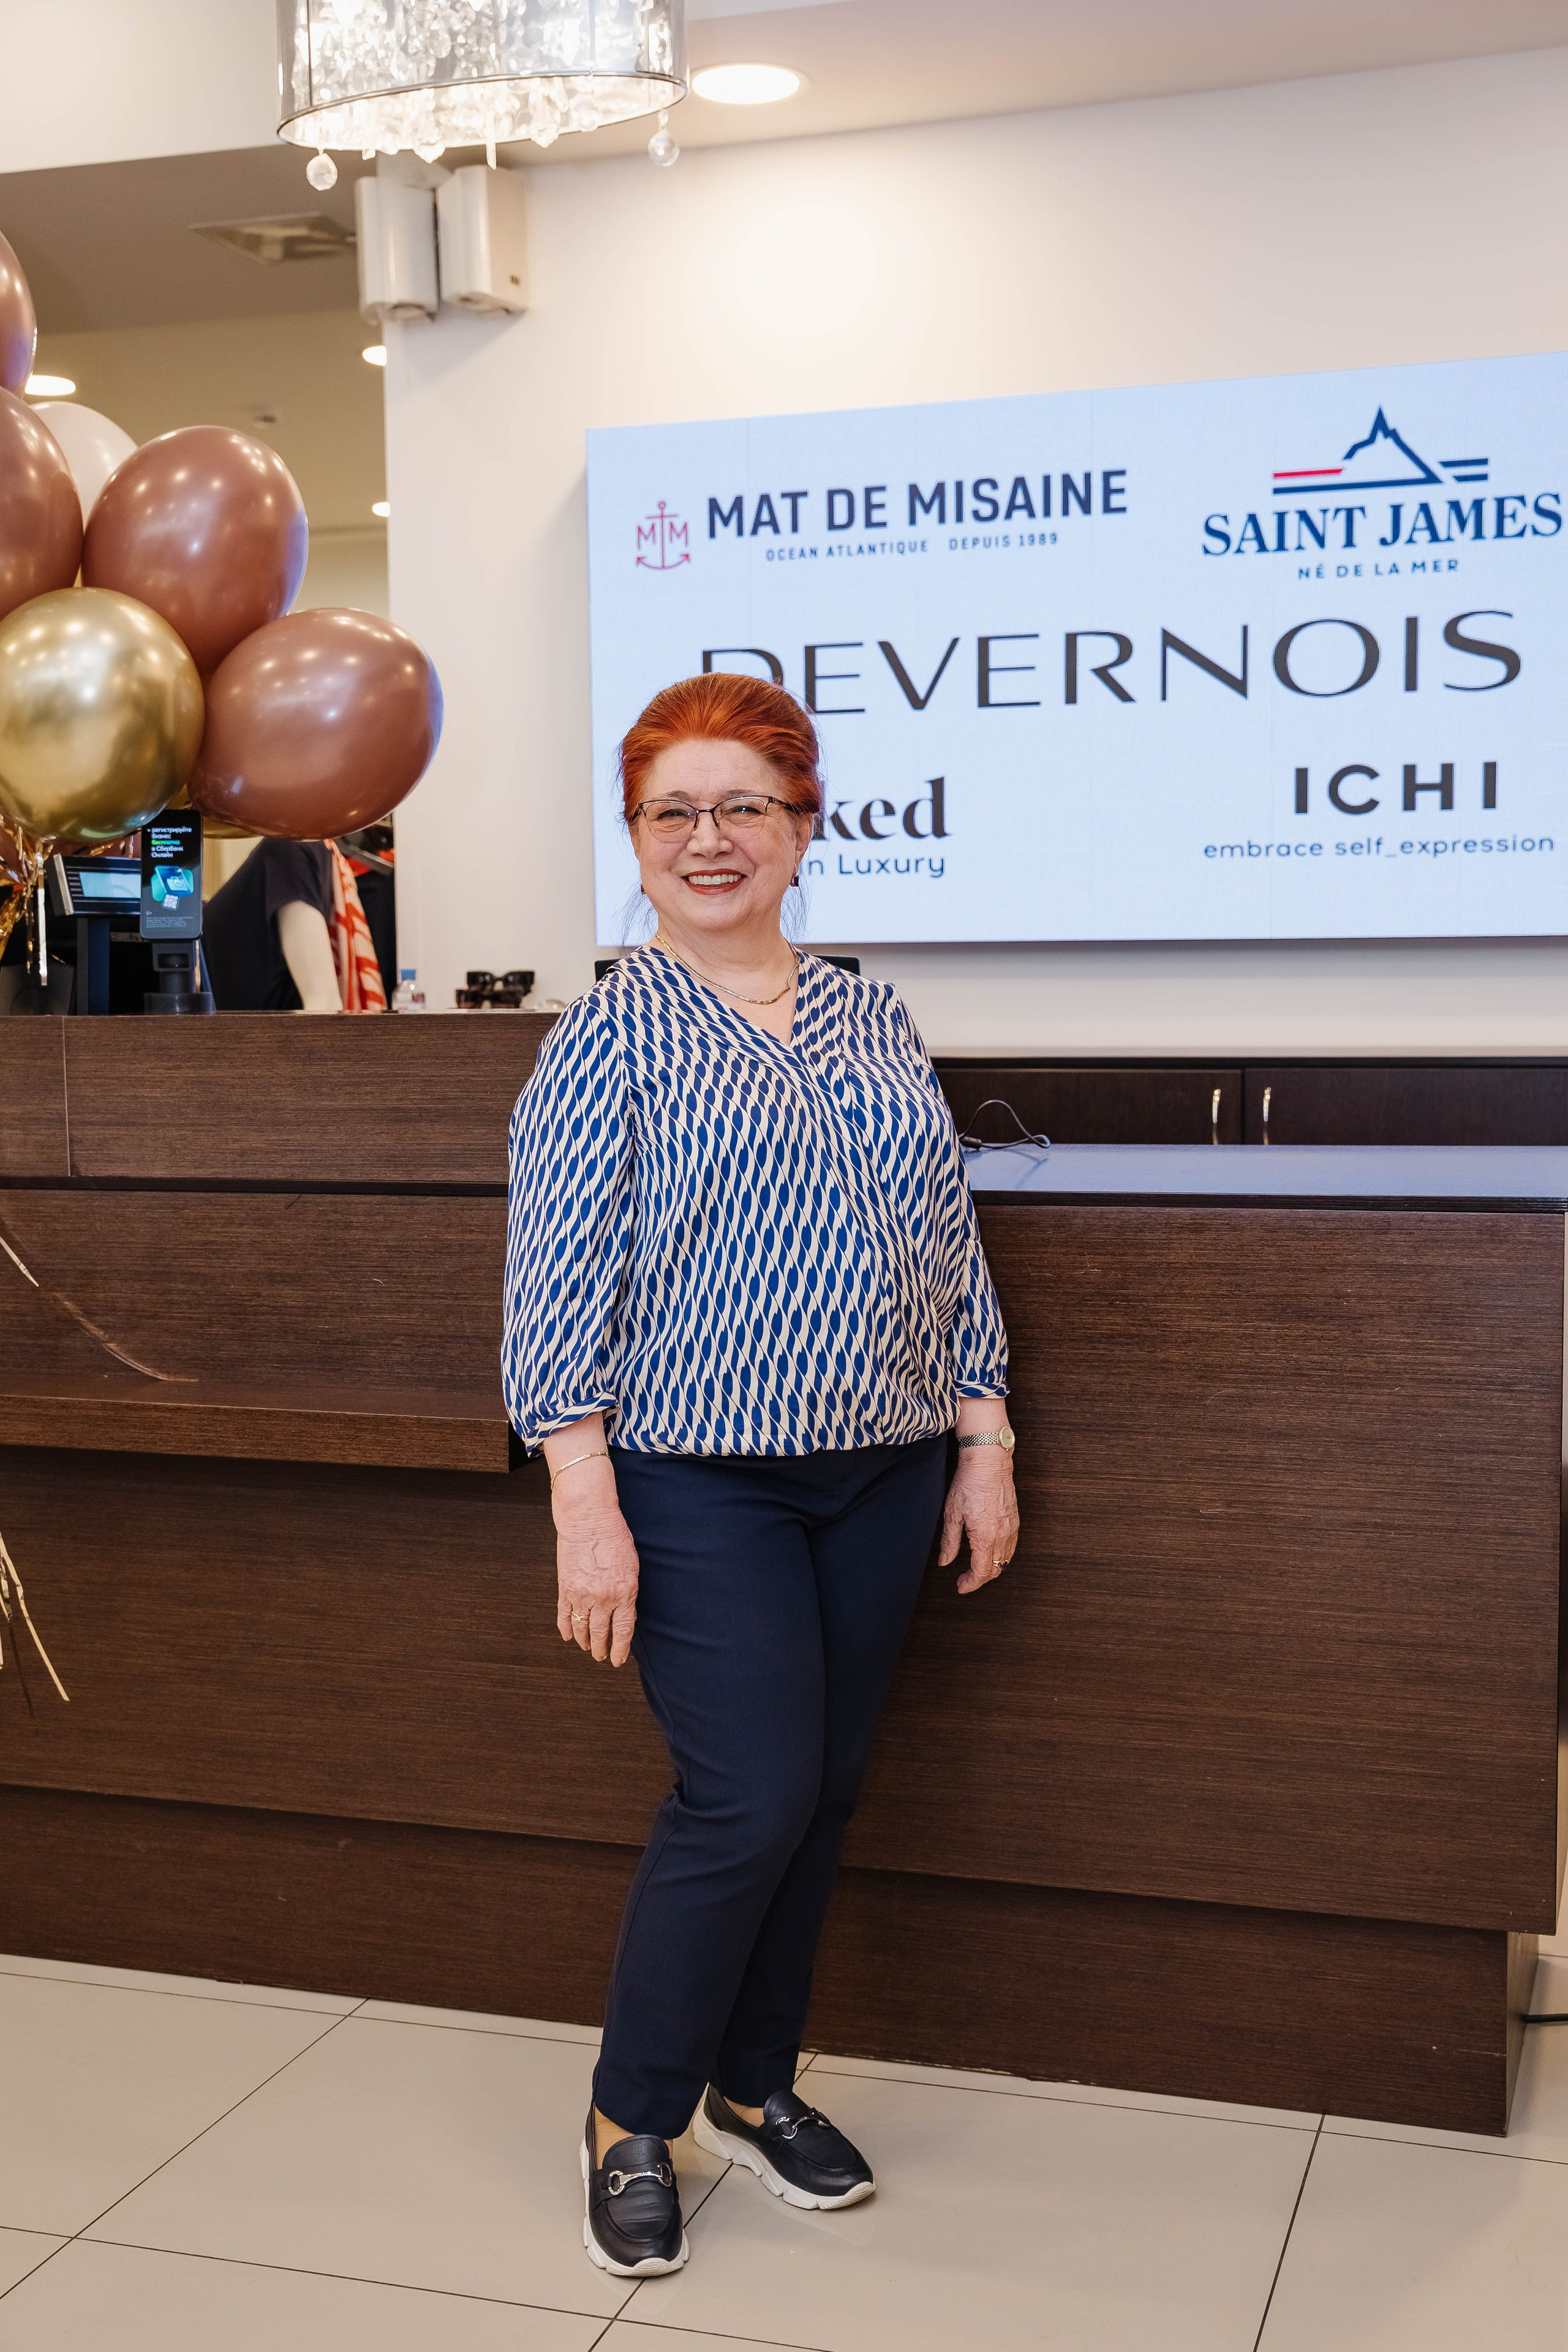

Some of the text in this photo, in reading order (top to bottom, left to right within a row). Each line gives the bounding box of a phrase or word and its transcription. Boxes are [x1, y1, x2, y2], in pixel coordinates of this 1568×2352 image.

[707, 469, 1128, 540] MAT DE MISAINE
[1202, 492, 1563, 556] SAINT JAMES
[766, 532, 1058, 562] OCEAN ATLANTIQUE DEPUIS 1989
[1298, 559, 1459, 580] NÉ DE LA MER
[1294, 761, 1497, 816] ICHI
[1204, 835, 1555, 859] embrace self_expression
[838, 854, 945, 879] Luxury
